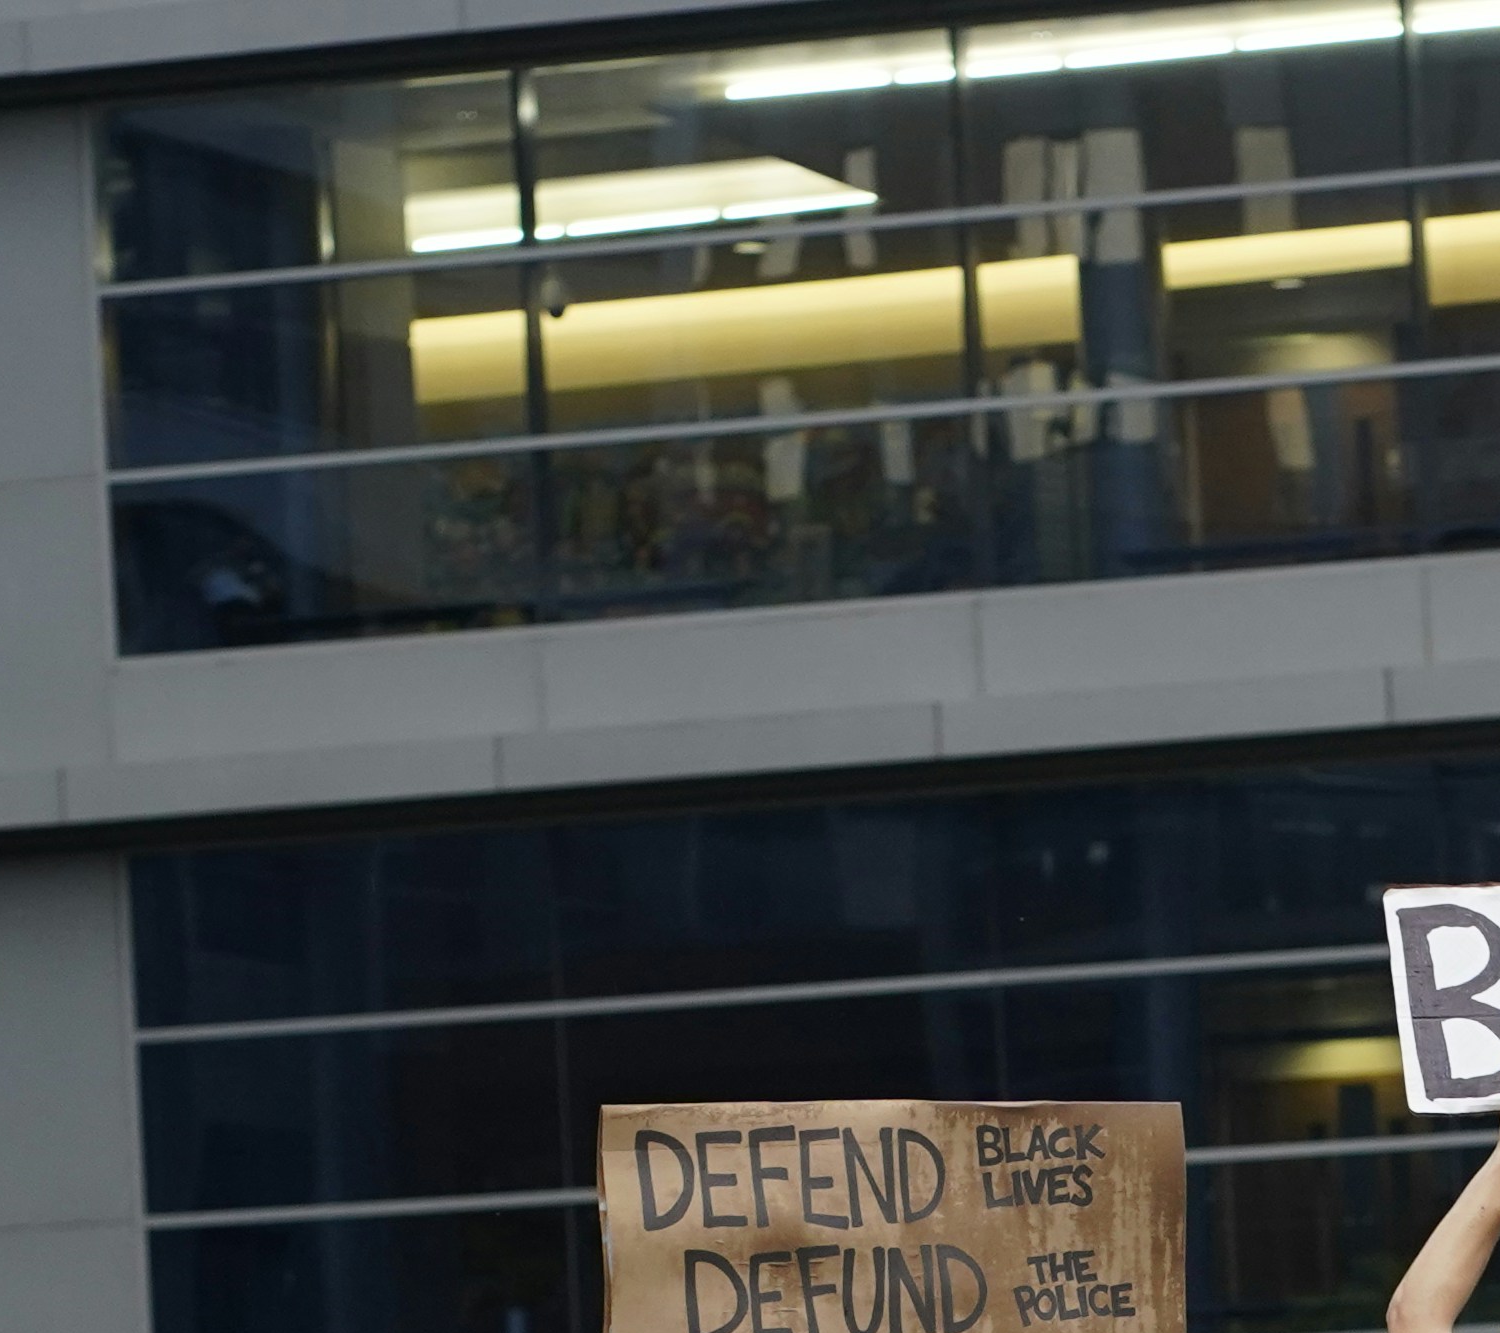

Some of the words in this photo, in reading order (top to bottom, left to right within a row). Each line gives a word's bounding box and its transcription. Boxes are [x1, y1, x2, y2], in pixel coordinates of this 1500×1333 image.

[976, 1124, 1106, 1166] BLACK
[634, 1125, 946, 1231] DEFEND
[982, 1164, 1094, 1209] LIVES
[1027, 1250, 1097, 1284] THE
[1012, 1282, 1136, 1328] POLICE
